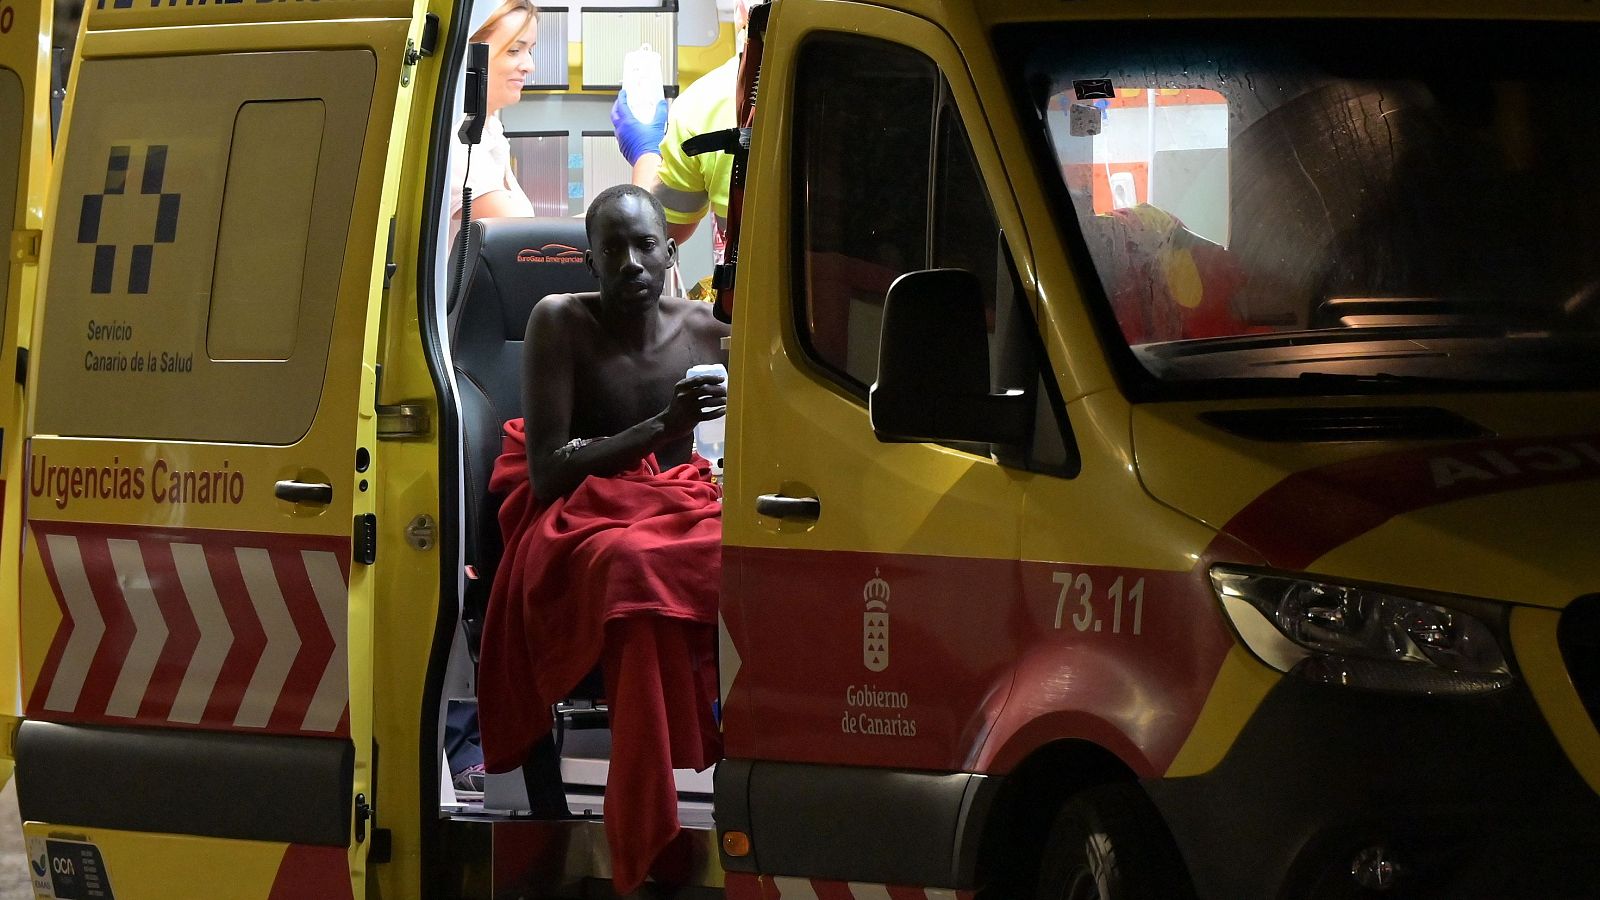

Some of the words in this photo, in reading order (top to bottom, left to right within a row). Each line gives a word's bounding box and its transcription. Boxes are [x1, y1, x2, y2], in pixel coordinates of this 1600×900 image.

[545, 255, 584, 264] Emergencias
[87, 320, 132, 341] Servicio
[84, 350, 127, 372] Canario
[130, 351, 144, 373] de
[147, 351, 157, 373] la
[160, 351, 193, 373] Salud
[30, 455, 145, 510] Urgencias
[152, 459, 244, 504] Canario
[1053, 571, 1145, 635] 73.11
[847, 684, 908, 709] Gobierno
[841, 711, 857, 734] de
[858, 713, 917, 737] Canarias
